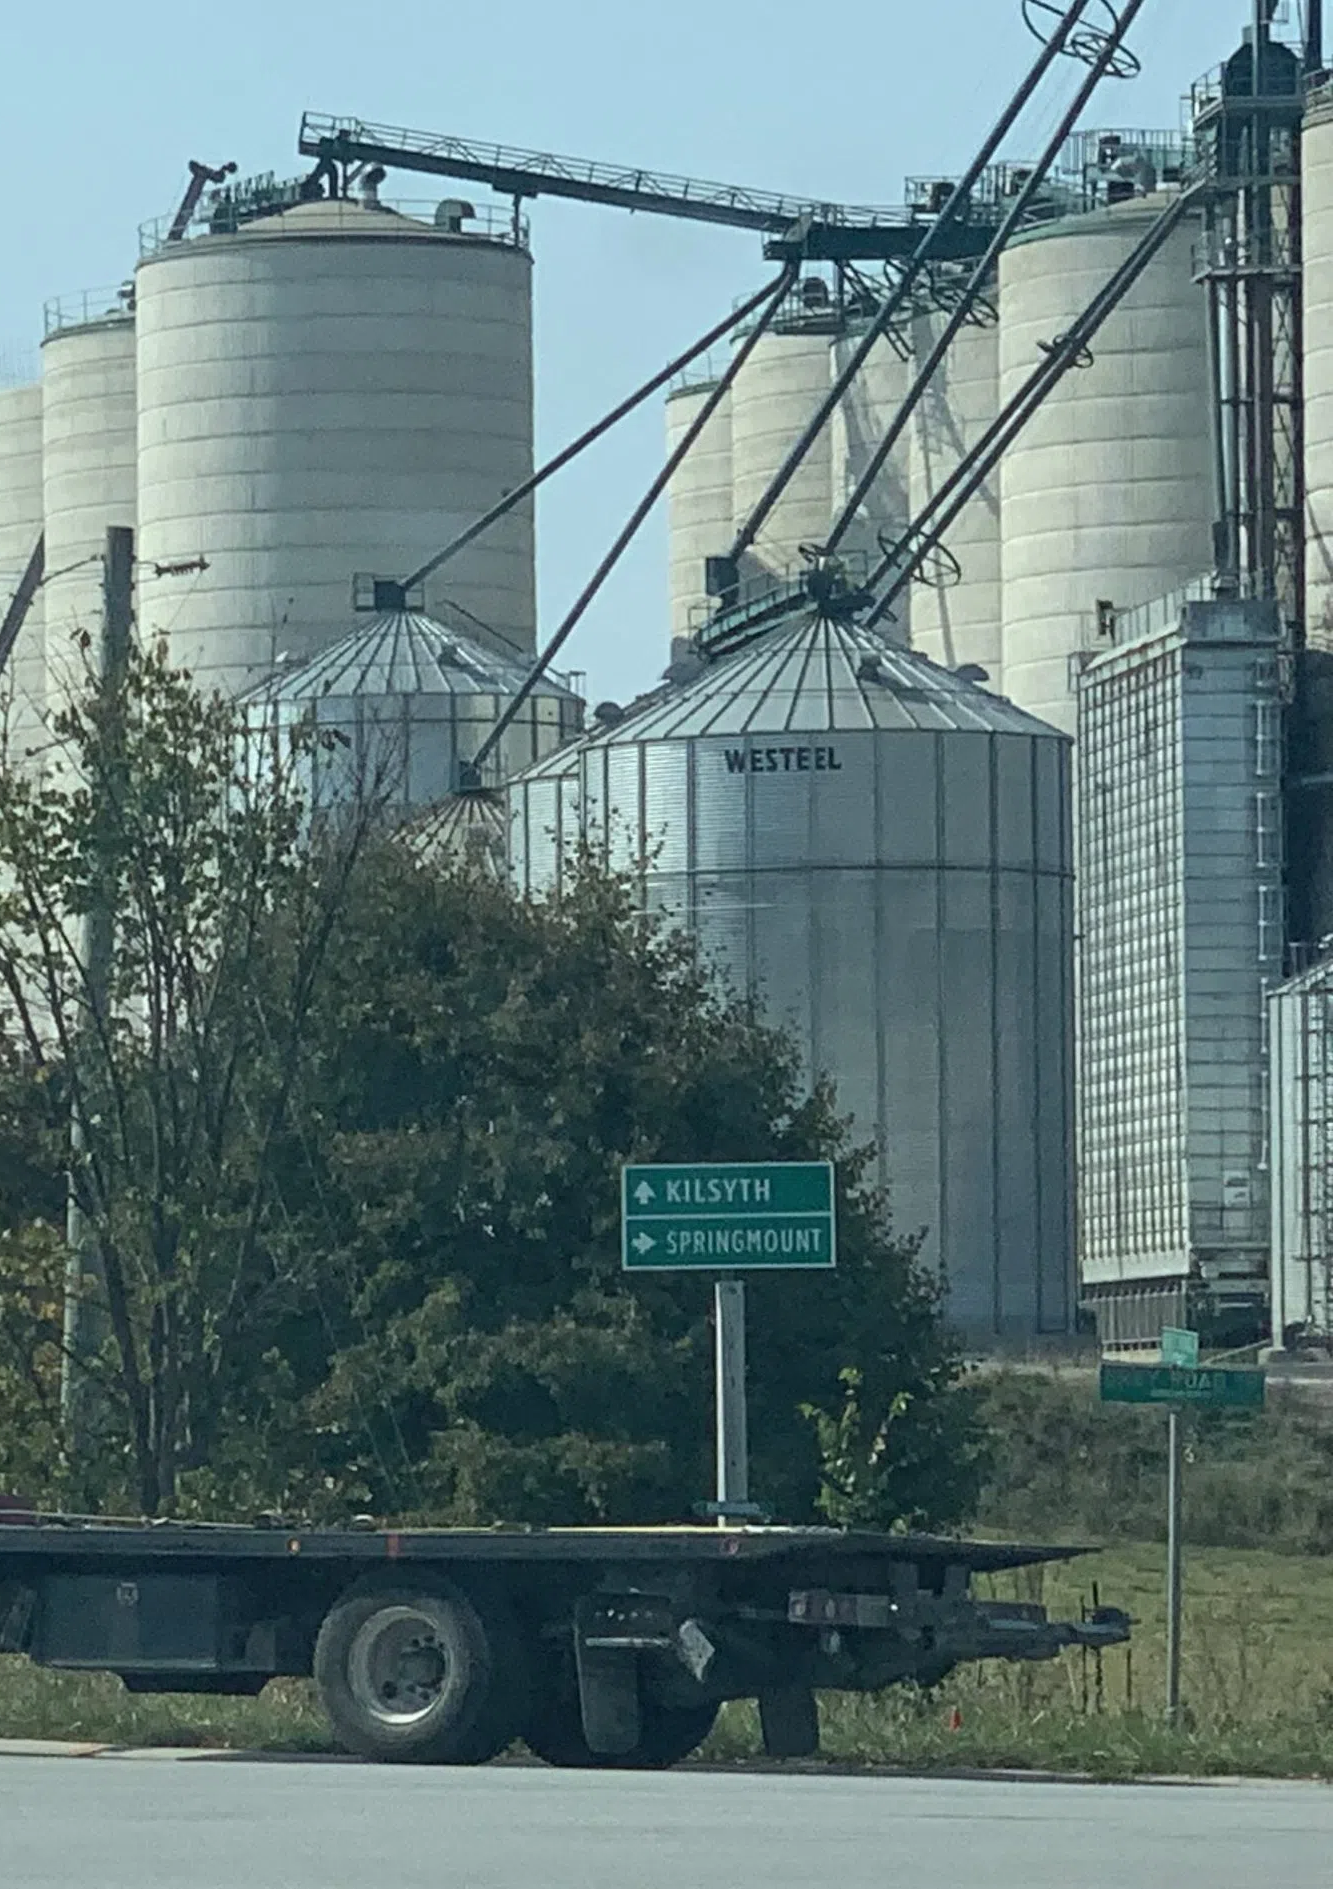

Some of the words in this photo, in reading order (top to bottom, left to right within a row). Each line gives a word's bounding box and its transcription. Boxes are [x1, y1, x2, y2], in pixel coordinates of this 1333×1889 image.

[724, 746, 842, 774] WESTEEL
[666, 1178, 771, 1203] KILSYTH
[666, 1228, 823, 1255] SPRINGMOUNT
